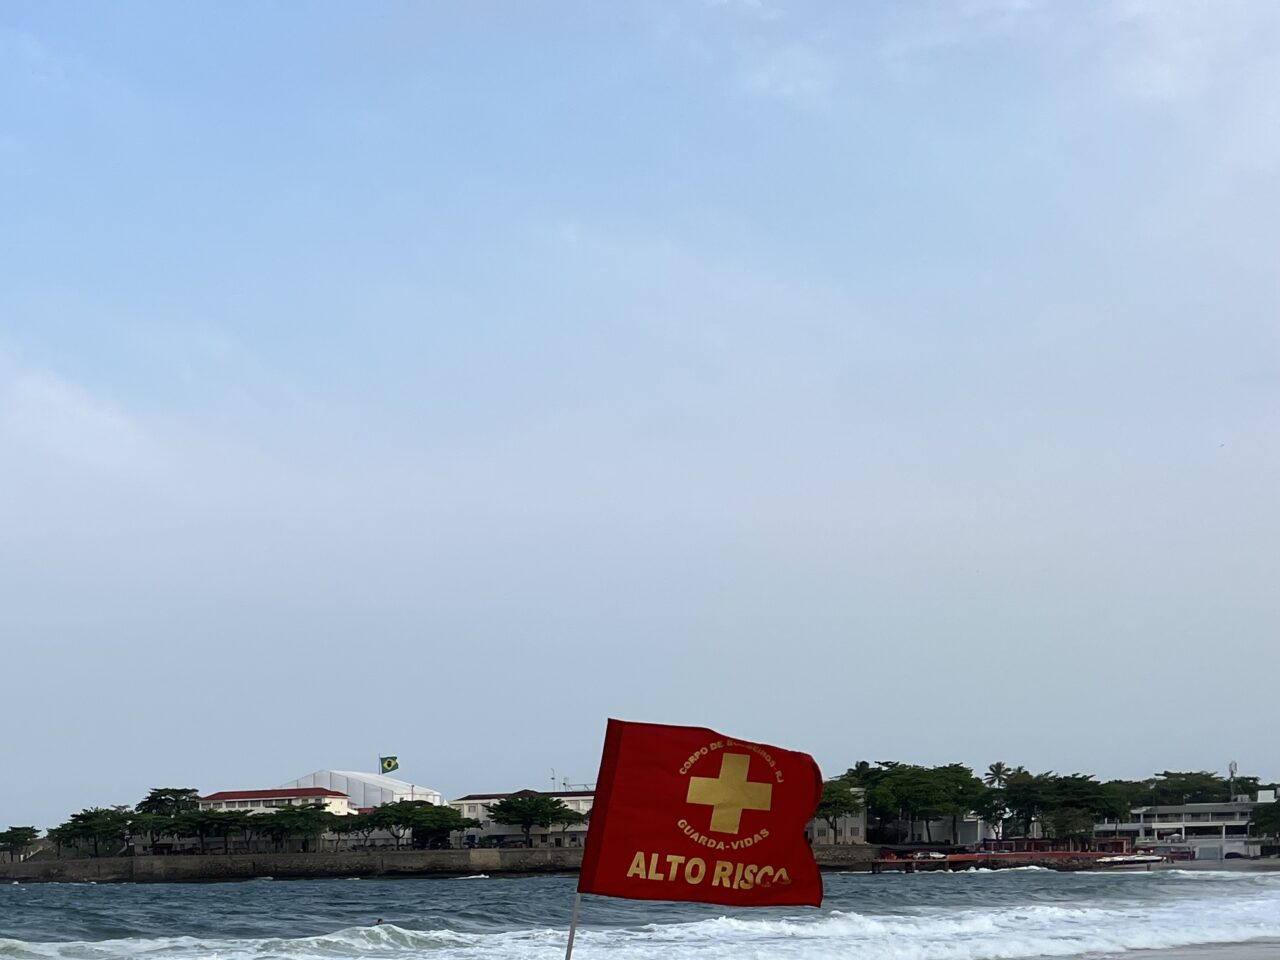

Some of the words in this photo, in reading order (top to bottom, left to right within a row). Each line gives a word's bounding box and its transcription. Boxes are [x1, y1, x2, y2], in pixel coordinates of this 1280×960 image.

[680, 746, 709, 775] CORPO
[709, 740, 725, 751] DE
[677, 818, 770, 851] GUARDA-VIDAS
[626, 851, 706, 885] ALTO
